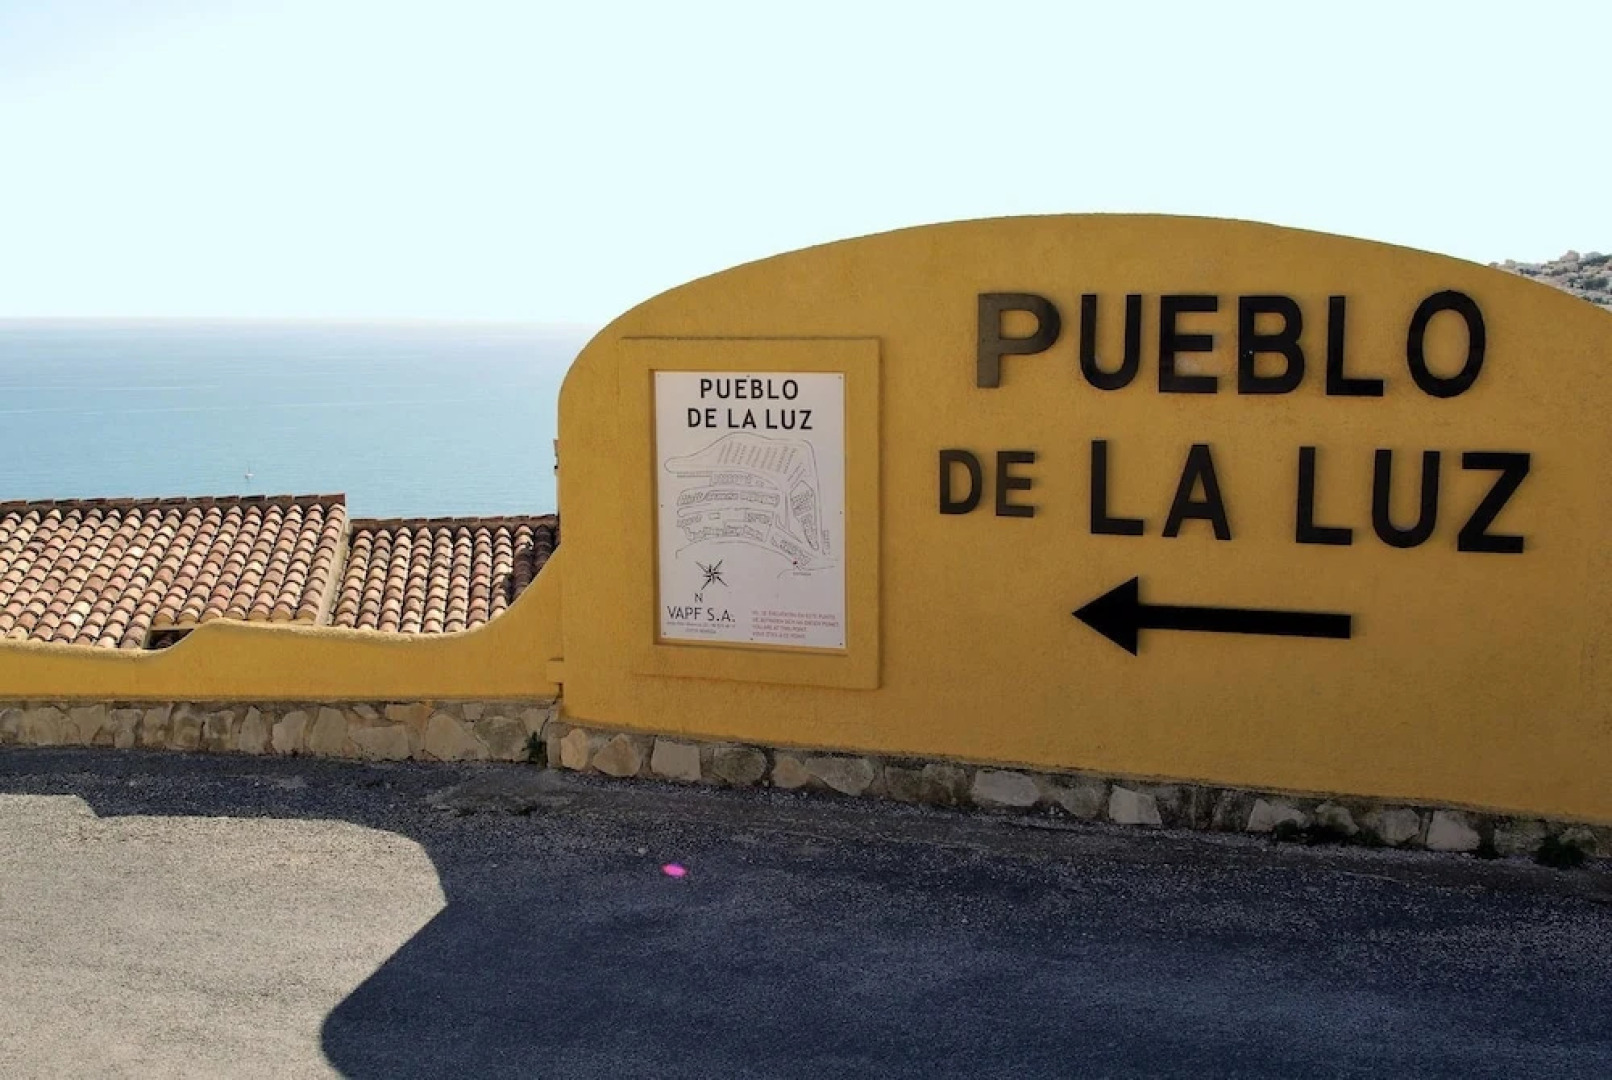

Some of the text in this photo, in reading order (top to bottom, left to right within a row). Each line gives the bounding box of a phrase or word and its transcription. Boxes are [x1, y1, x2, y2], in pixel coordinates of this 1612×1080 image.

[976, 289, 1486, 398] PUEBLO
[700, 378, 798, 400] PUEBLO
[688, 407, 813, 430] DE LA LUZ
[939, 439, 1530, 553] DE LA LUZ
[694, 592, 703, 603] N
[667, 605, 702, 620] VAPF
